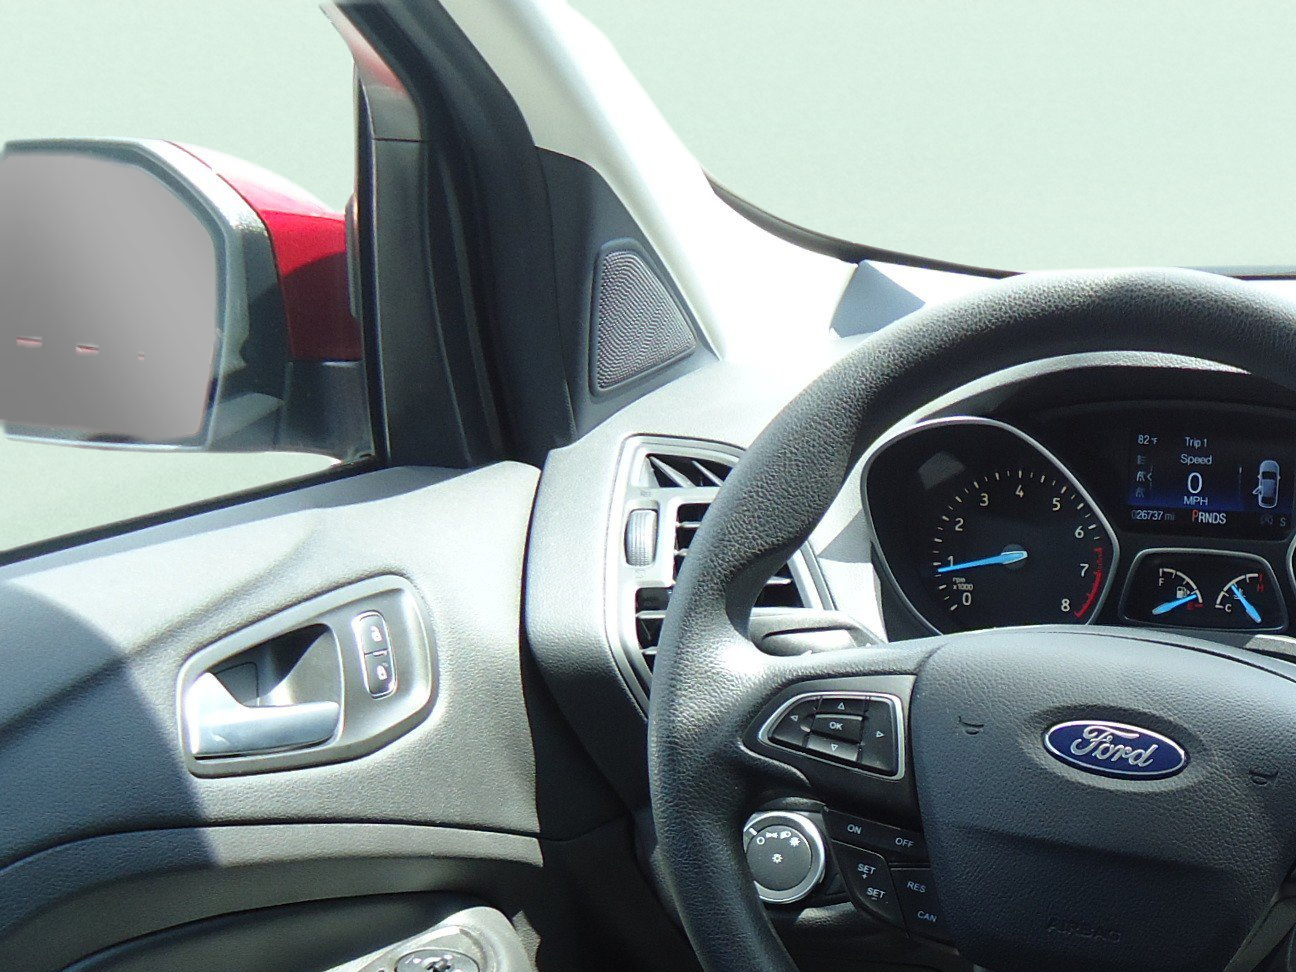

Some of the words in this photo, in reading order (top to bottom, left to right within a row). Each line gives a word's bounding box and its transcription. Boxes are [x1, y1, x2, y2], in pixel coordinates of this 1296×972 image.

[1138, 434, 1149, 445] 82
[1185, 437, 1200, 449] Trip
[1203, 438, 1208, 448] 1
[1180, 453, 1213, 465] Speed
[1187, 472, 1203, 494] 0
[1015, 484, 1025, 498] 4
[980, 493, 989, 506] 3
[1052, 498, 1061, 511] 5
[1183, 496, 1208, 506] MPH
[955, 518, 964, 531] 2
[1075, 526, 1084, 539] 6
[1080, 563, 1089, 577] 7
[1158, 578, 1165, 587] F
[962, 592, 972, 606] 0
[1061, 599, 1070, 612] 8
[1225, 604, 1232, 613] C
[829, 721, 843, 731] OK
[1070, 725, 1159, 767] Ford
[847, 825, 862, 835] ON
[895, 838, 913, 848] OFF
[857, 864, 875, 875] SET
[867, 887, 886, 899] SET
[907, 881, 926, 893] RES
[917, 910, 937, 922] CAN
